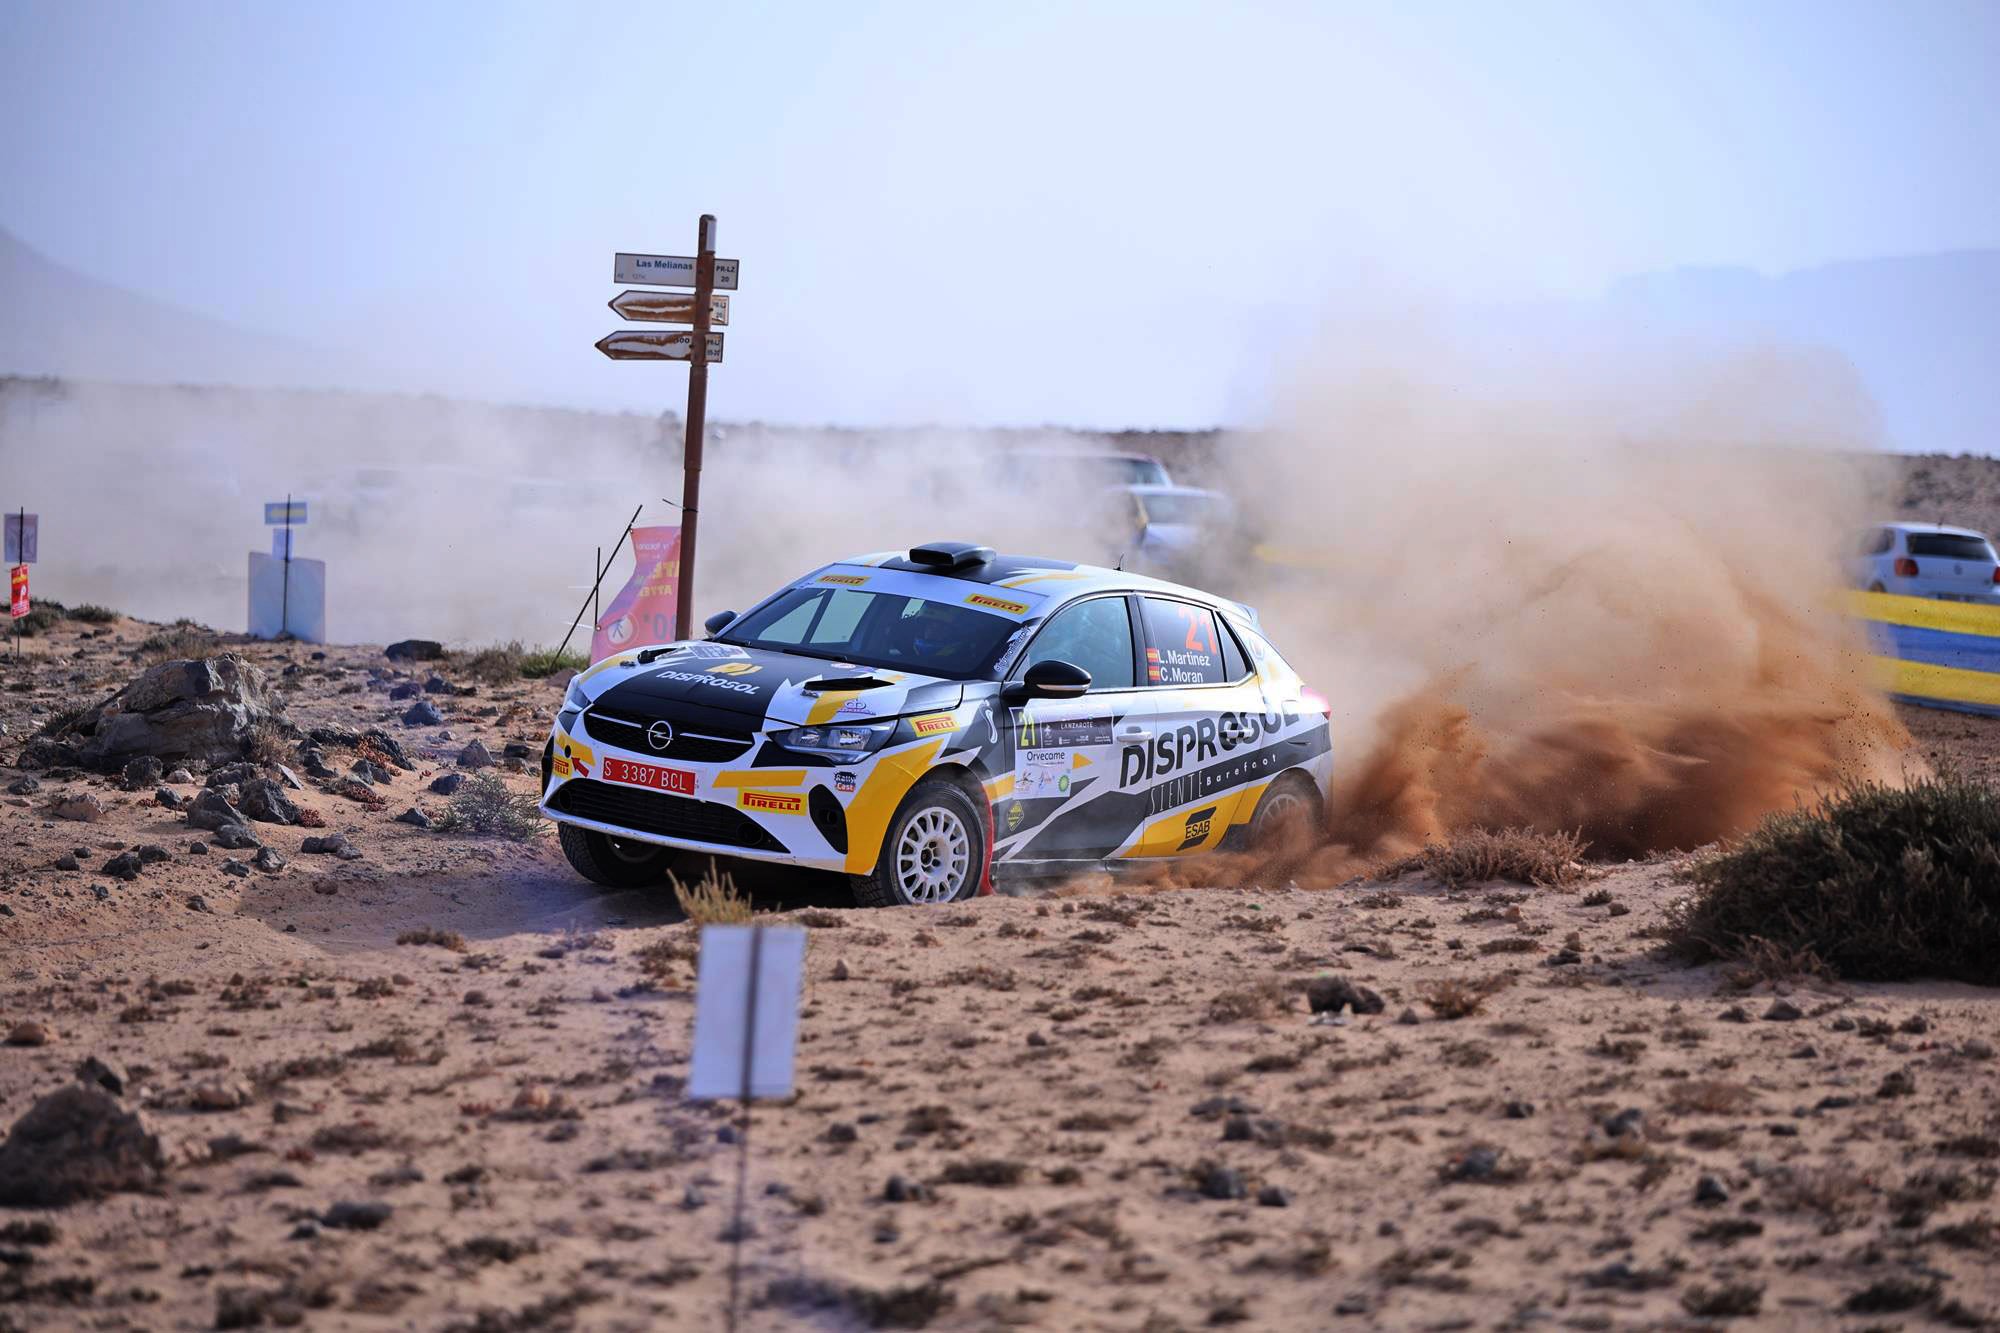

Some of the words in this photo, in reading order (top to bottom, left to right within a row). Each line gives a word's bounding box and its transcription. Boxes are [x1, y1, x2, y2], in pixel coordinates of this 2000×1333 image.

[636, 259, 652, 268] Las
[654, 260, 693, 270] Melianas
[716, 265, 736, 273] PR-LZ
[971, 595, 1024, 612] PIRELLI
[1178, 606, 1217, 656] 21
[656, 670, 760, 695] DISPROSOL
[1160, 666, 1204, 683] C.Moran
[915, 716, 955, 733] PIRELLI
[1026, 751, 1065, 761] Orvecame
[604, 760, 612, 777] S
[621, 763, 656, 785] 3387
[661, 768, 687, 791] BCL
[1150, 770, 1204, 817] SIENTE
[1206, 752, 1278, 787] Barefoot
[743, 792, 801, 811] PIRELLI
[1185, 820, 1211, 839] ESAB
